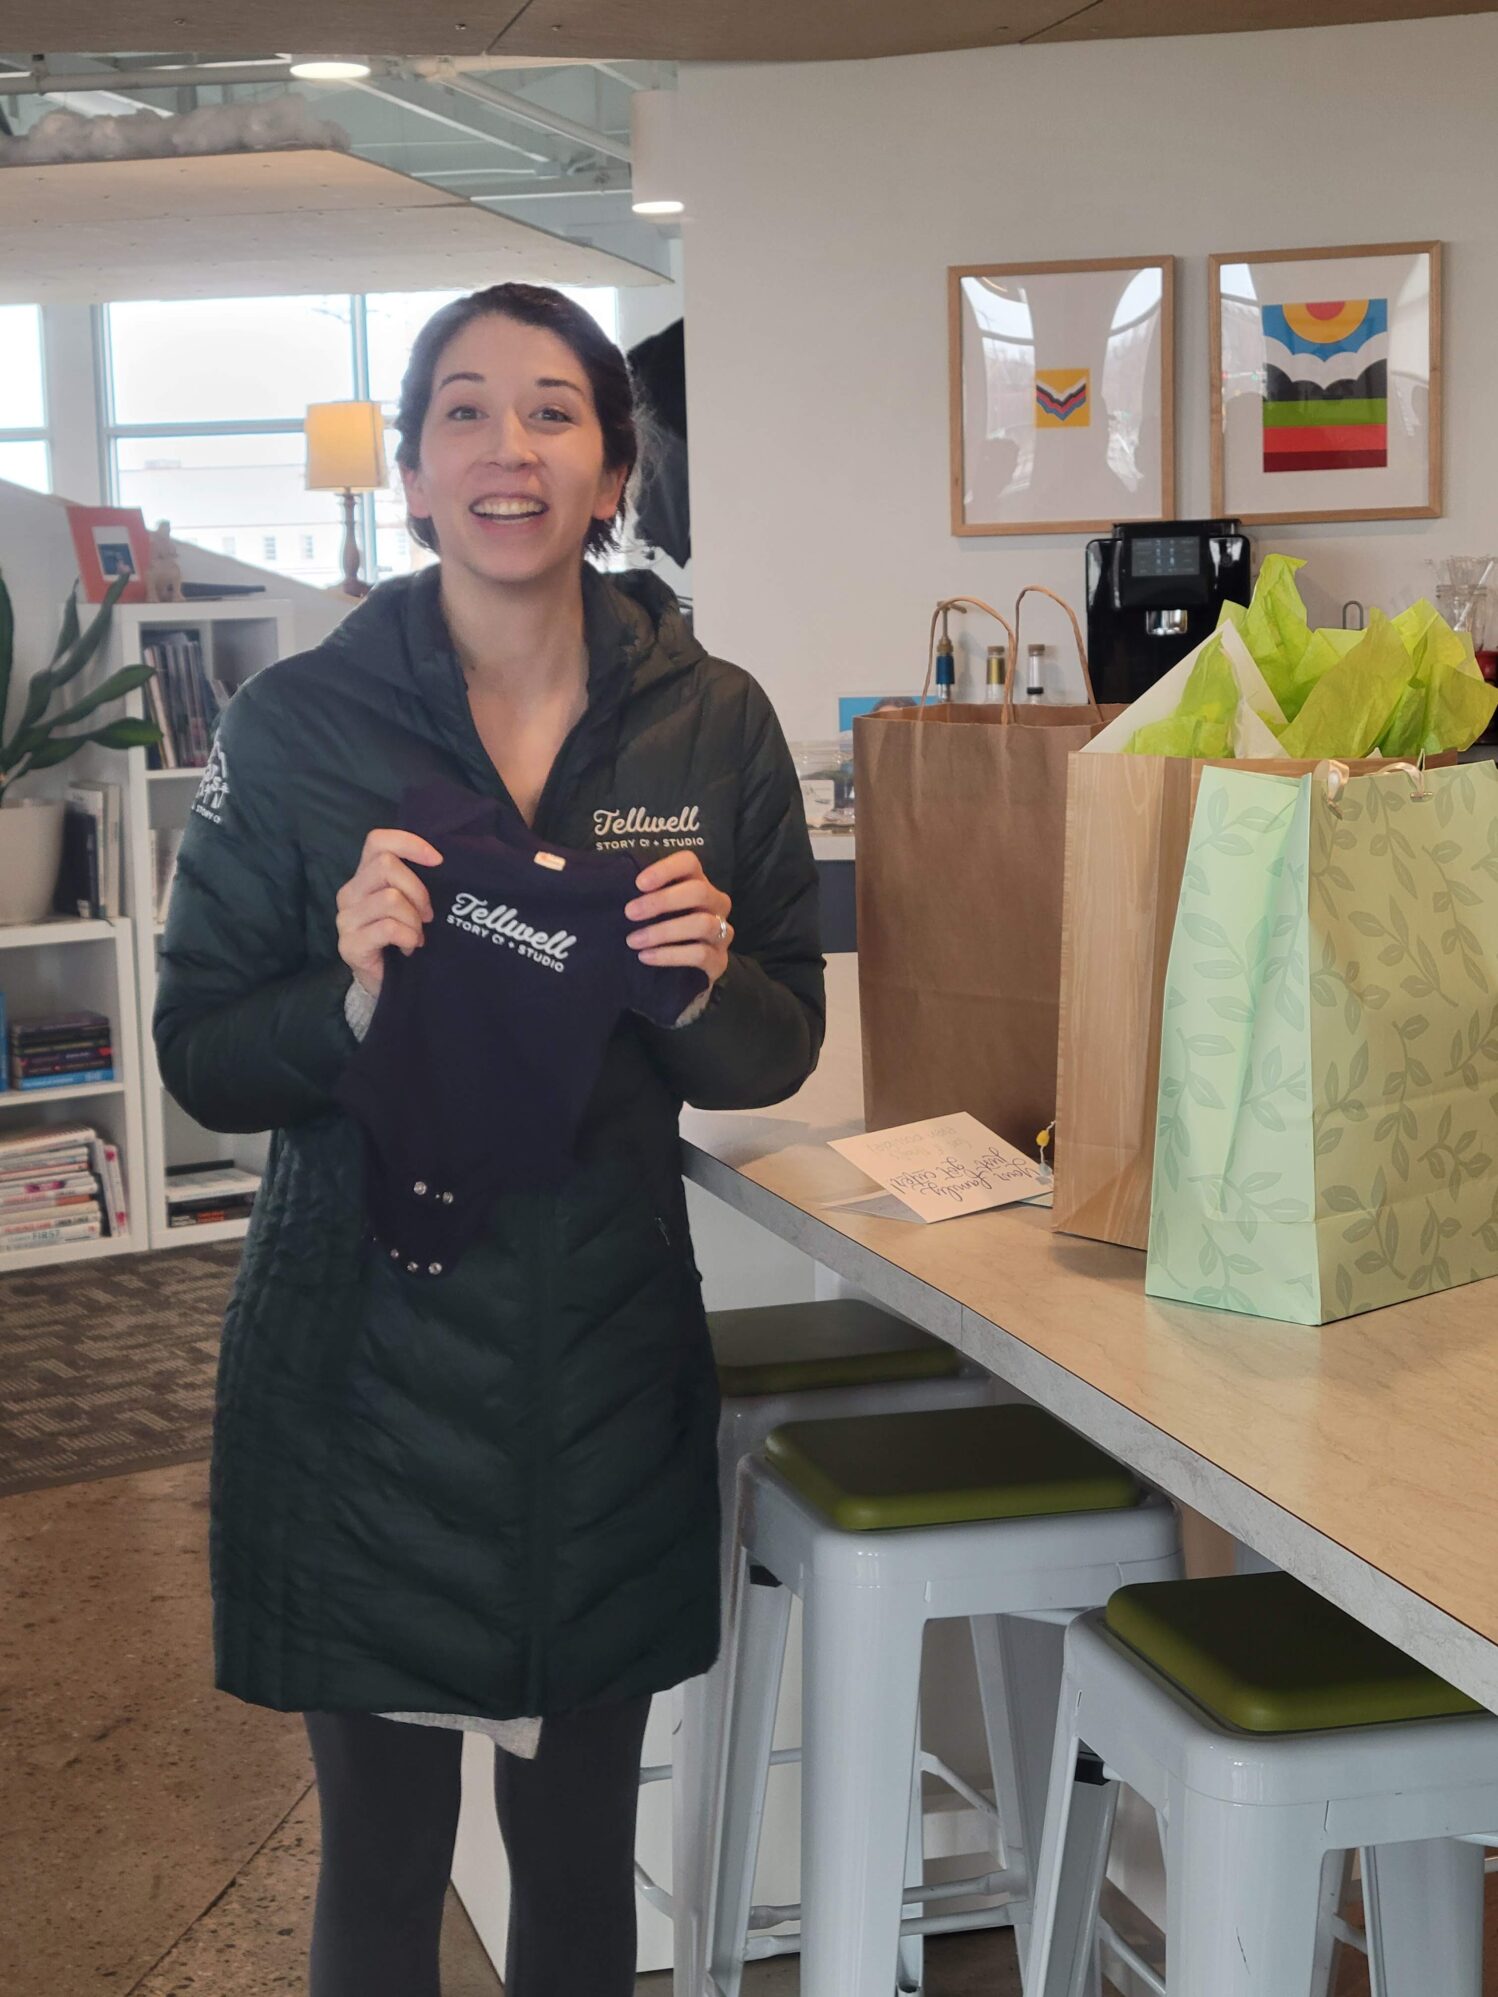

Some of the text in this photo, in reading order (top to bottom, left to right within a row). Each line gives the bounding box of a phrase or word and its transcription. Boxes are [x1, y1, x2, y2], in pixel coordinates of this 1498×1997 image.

[593, 805, 700, 836] Tellwell
[595, 839, 636, 851] STORY
[662, 837, 704, 848] STUDIO
[451, 892, 577, 960] Tellwell
[446, 914, 490, 938] STORY
[517, 944, 565, 973] STUDIO
[936, 1157, 966, 1180] got
[975, 1147, 1007, 1170] just
[920, 1169, 992, 1202] family
